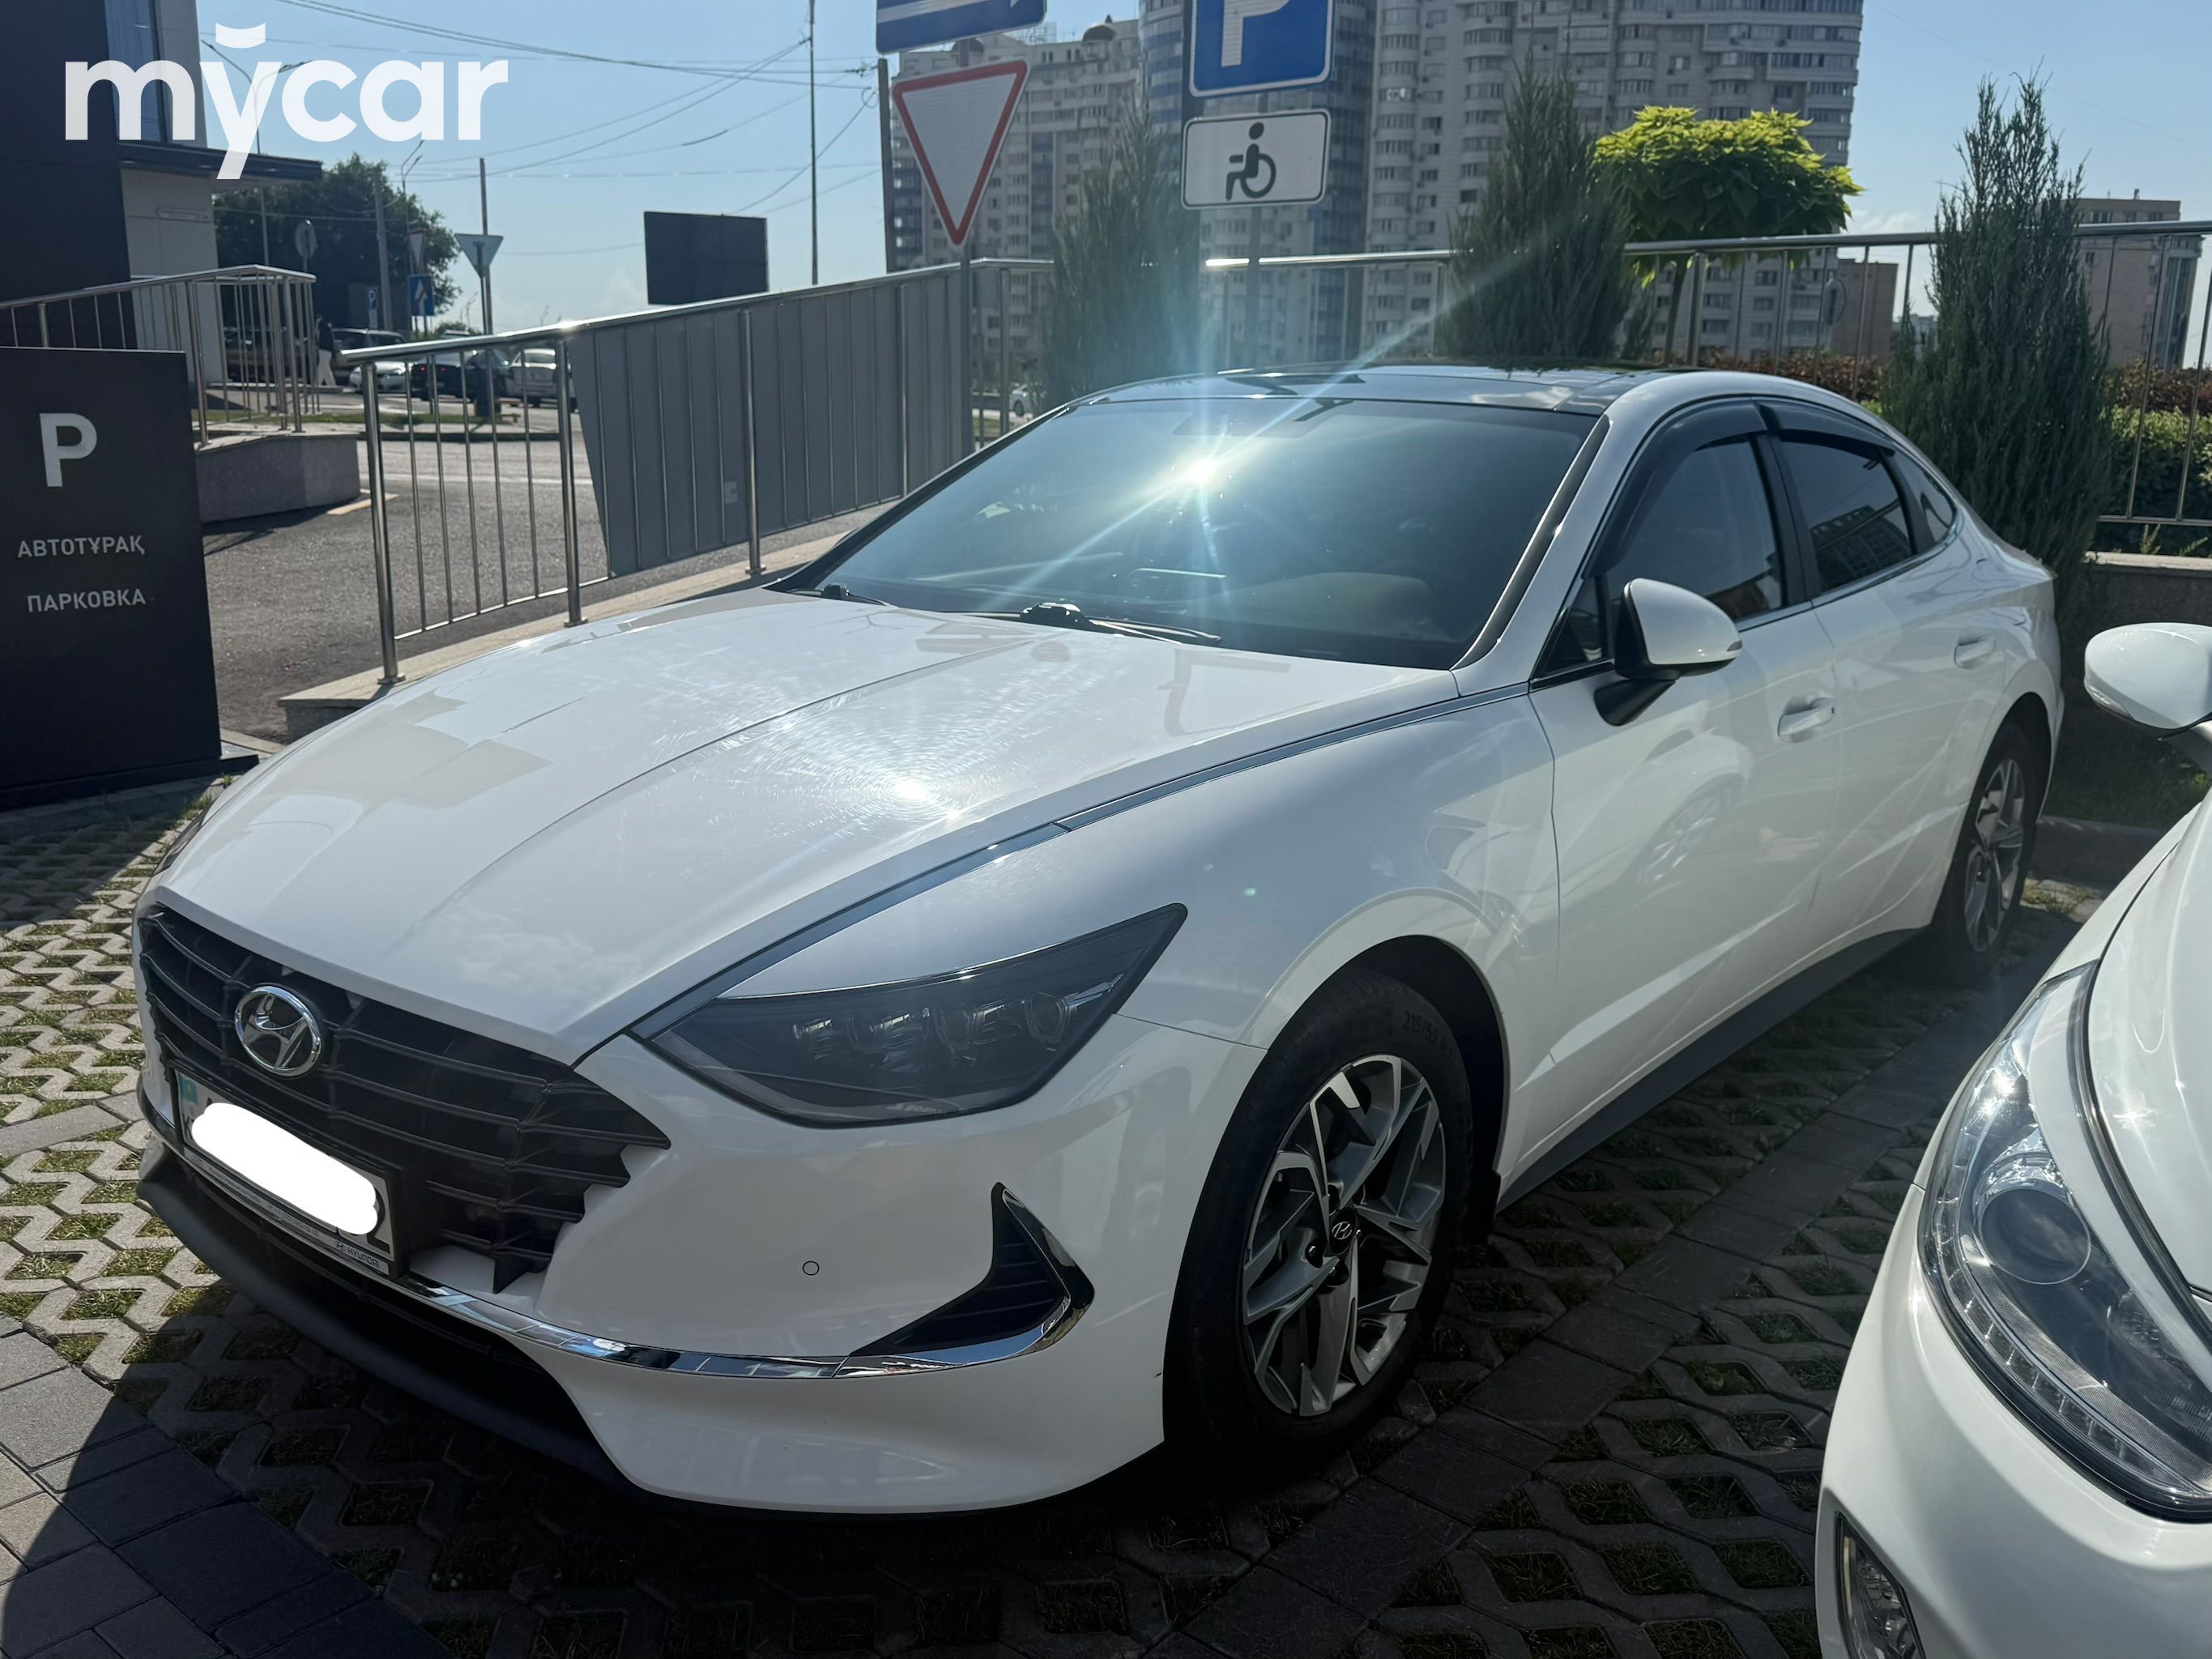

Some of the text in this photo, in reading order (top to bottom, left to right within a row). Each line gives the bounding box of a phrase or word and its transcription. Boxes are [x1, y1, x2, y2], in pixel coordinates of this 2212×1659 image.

[39, 412, 98, 488] P
[17, 535, 146, 558] АВТОТҰРАҚ
[27, 588, 147, 613] ПАРКОВКА
[347, 1247, 381, 1269] HYUNDAI
